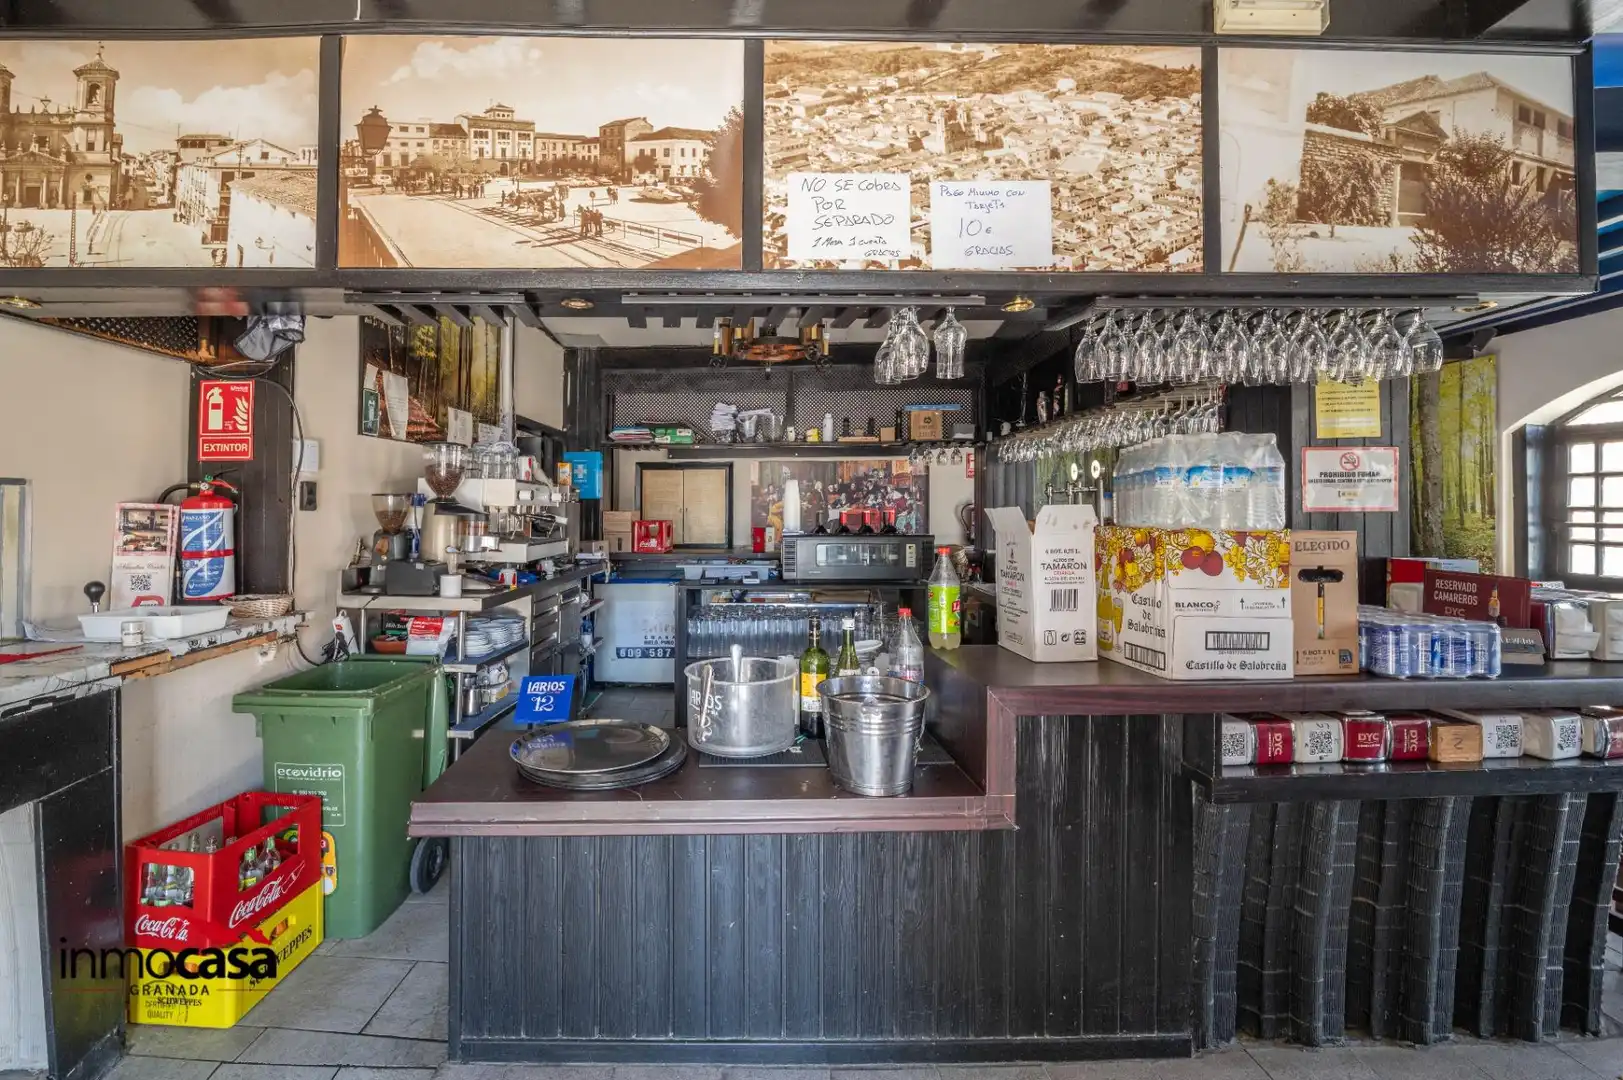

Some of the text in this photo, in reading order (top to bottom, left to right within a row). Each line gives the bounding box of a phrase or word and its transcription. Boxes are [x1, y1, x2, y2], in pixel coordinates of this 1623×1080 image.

[801, 177, 827, 192] NO
[834, 178, 854, 192] SE
[811, 196, 846, 213] POR
[812, 213, 895, 231] SEPARADO
[204, 444, 248, 452] EXTINTOR
[1294, 540, 1350, 552] ELEGIDO
[1435, 579, 1477, 593] RESERVADO
[1433, 591, 1478, 606] CAMAREROS
[1444, 606, 1466, 617] DYC
[649, 648, 671, 657] 587
[1185, 660, 1287, 671] Castillo de Salobreña
[527, 681, 567, 694] LARIOS
[531, 695, 554, 712] 12
[690, 690, 724, 711] AROS
[1358, 732, 1380, 741] DYC
[1410, 729, 1418, 752] DYC
[1273, 732, 1283, 756] DYC
[277, 767, 342, 778] ecovidrio
[147, 1010, 174, 1019] QUALITY
